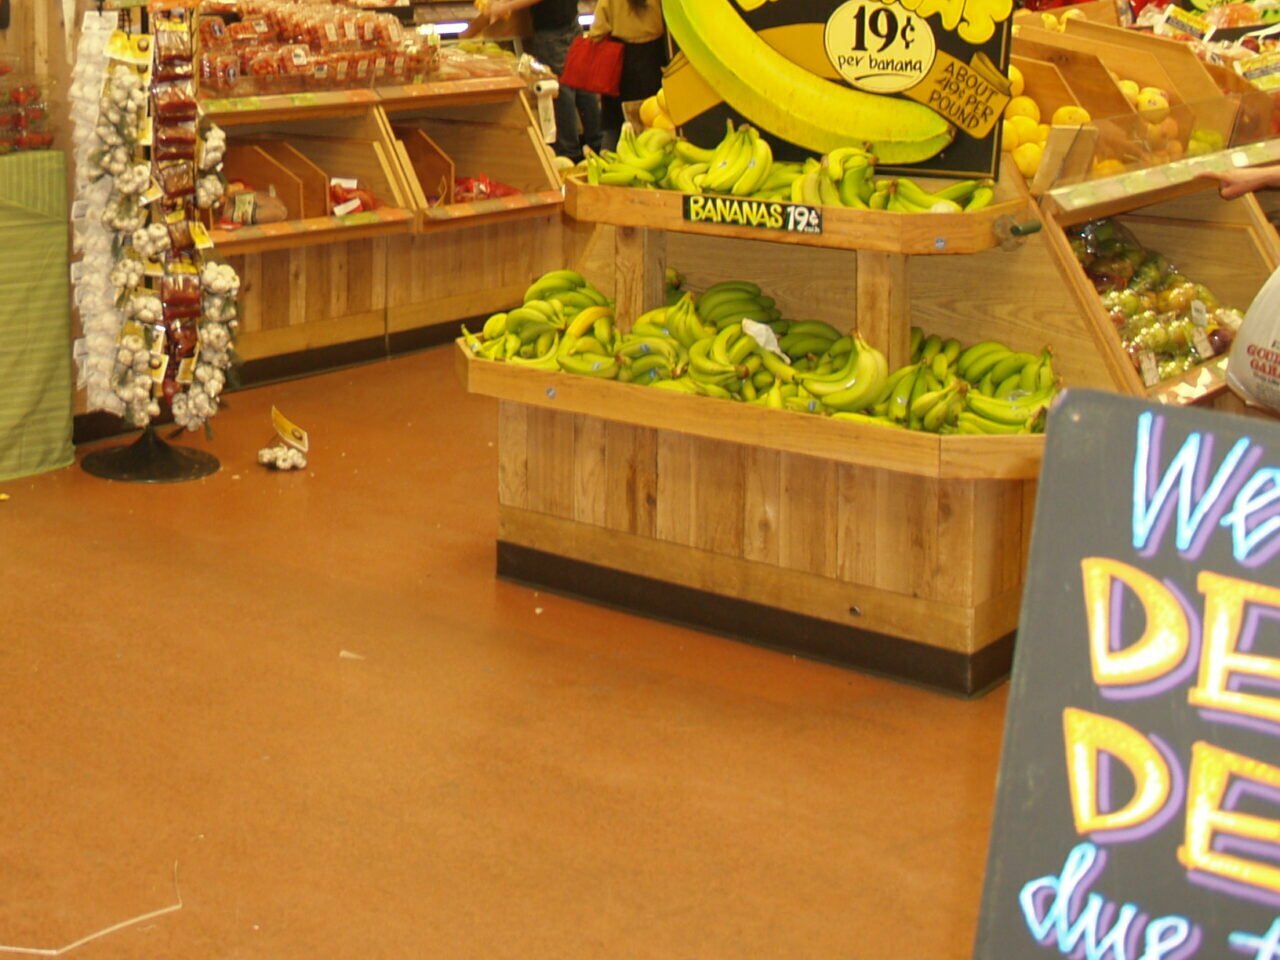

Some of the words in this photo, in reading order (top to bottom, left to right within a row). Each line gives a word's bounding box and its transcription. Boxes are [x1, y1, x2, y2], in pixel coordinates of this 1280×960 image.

[837, 54, 864, 70] per
[869, 54, 923, 74] banana
[943, 61, 999, 105] ABOUT
[928, 88, 980, 129] POUND
[965, 93, 994, 123] PER
[689, 195, 784, 229] BANANAS
